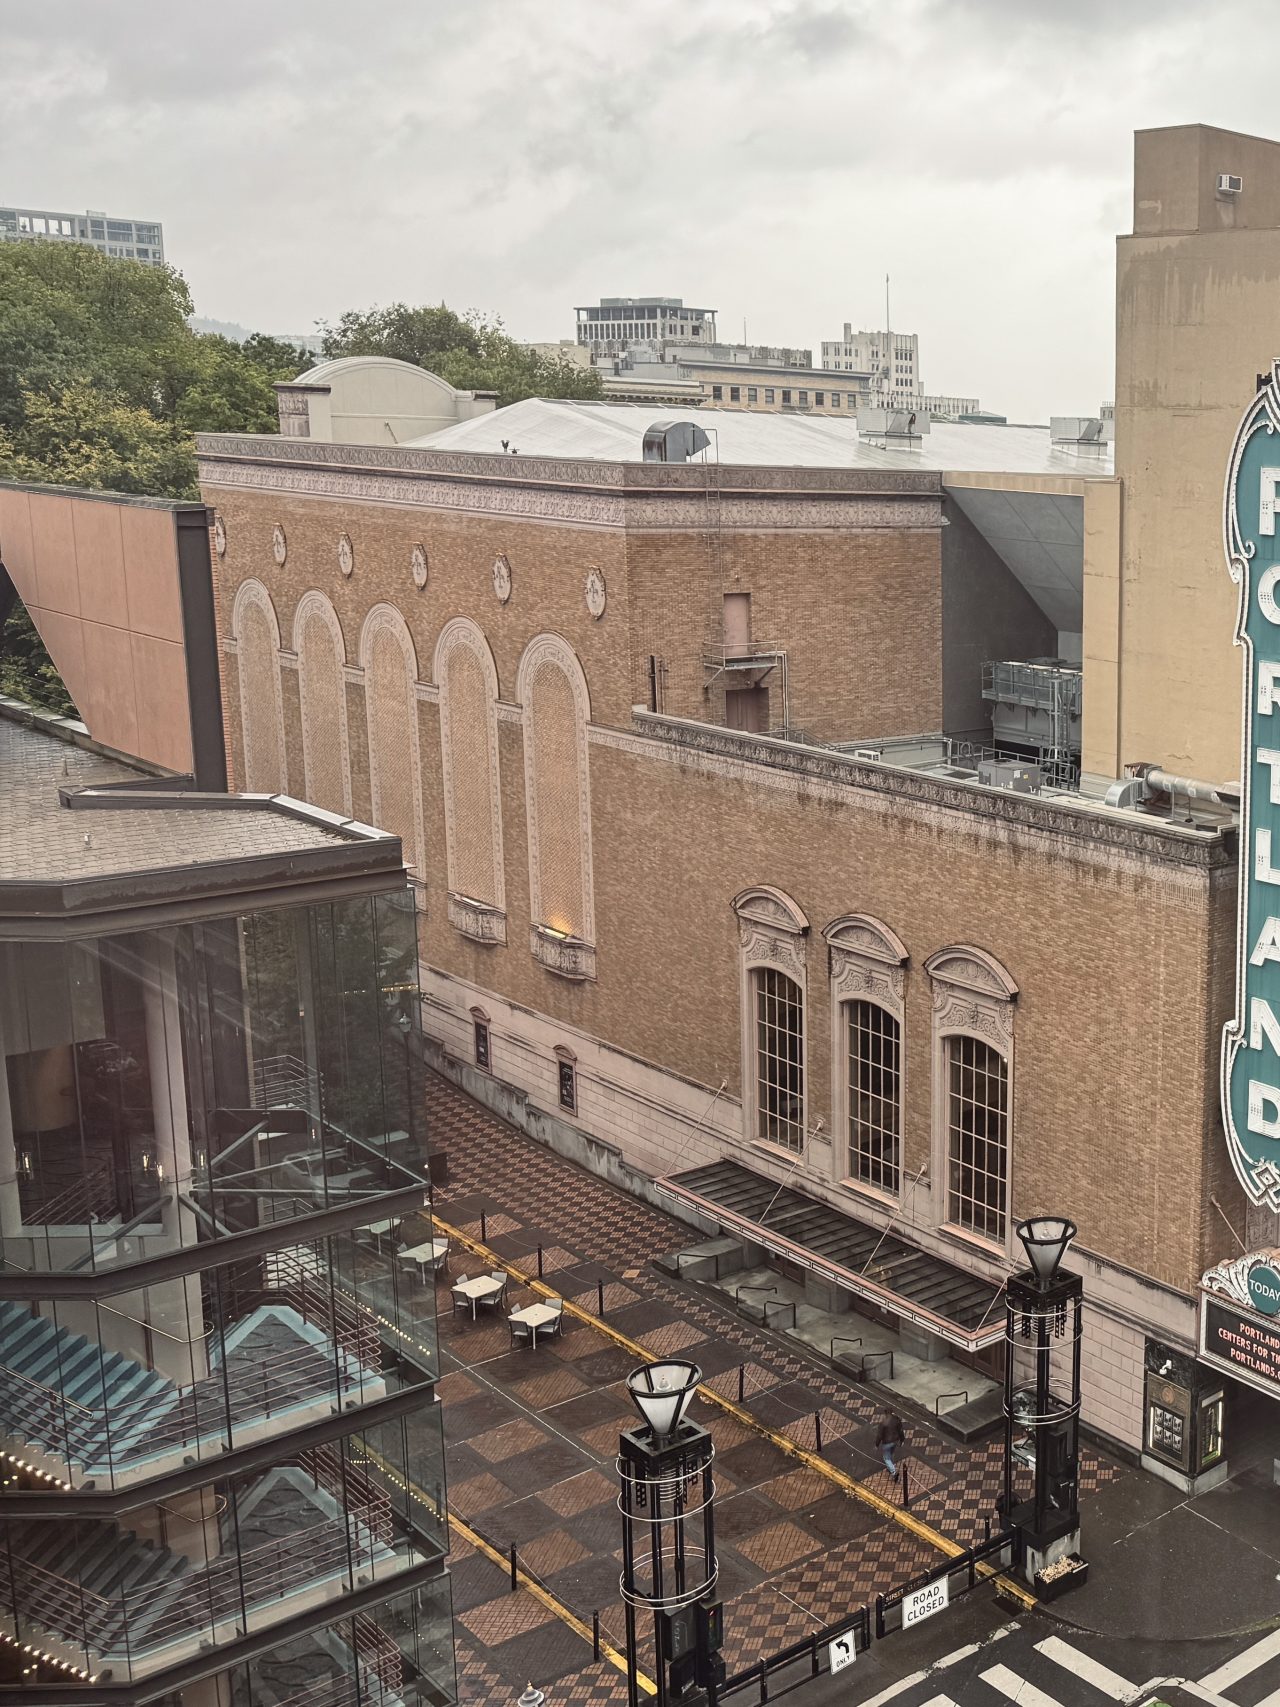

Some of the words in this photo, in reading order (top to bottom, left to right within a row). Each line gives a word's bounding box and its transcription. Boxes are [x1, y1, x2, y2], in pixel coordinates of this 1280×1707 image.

[1249, 1279, 1280, 1301] TODAY
[1218, 1327, 1251, 1350] CENTERS
[1253, 1343, 1268, 1358] FOR
[912, 1585, 940, 1606] ROAD
[907, 1595, 945, 1622] CLOSED
[836, 1655, 851, 1668] ONLY
